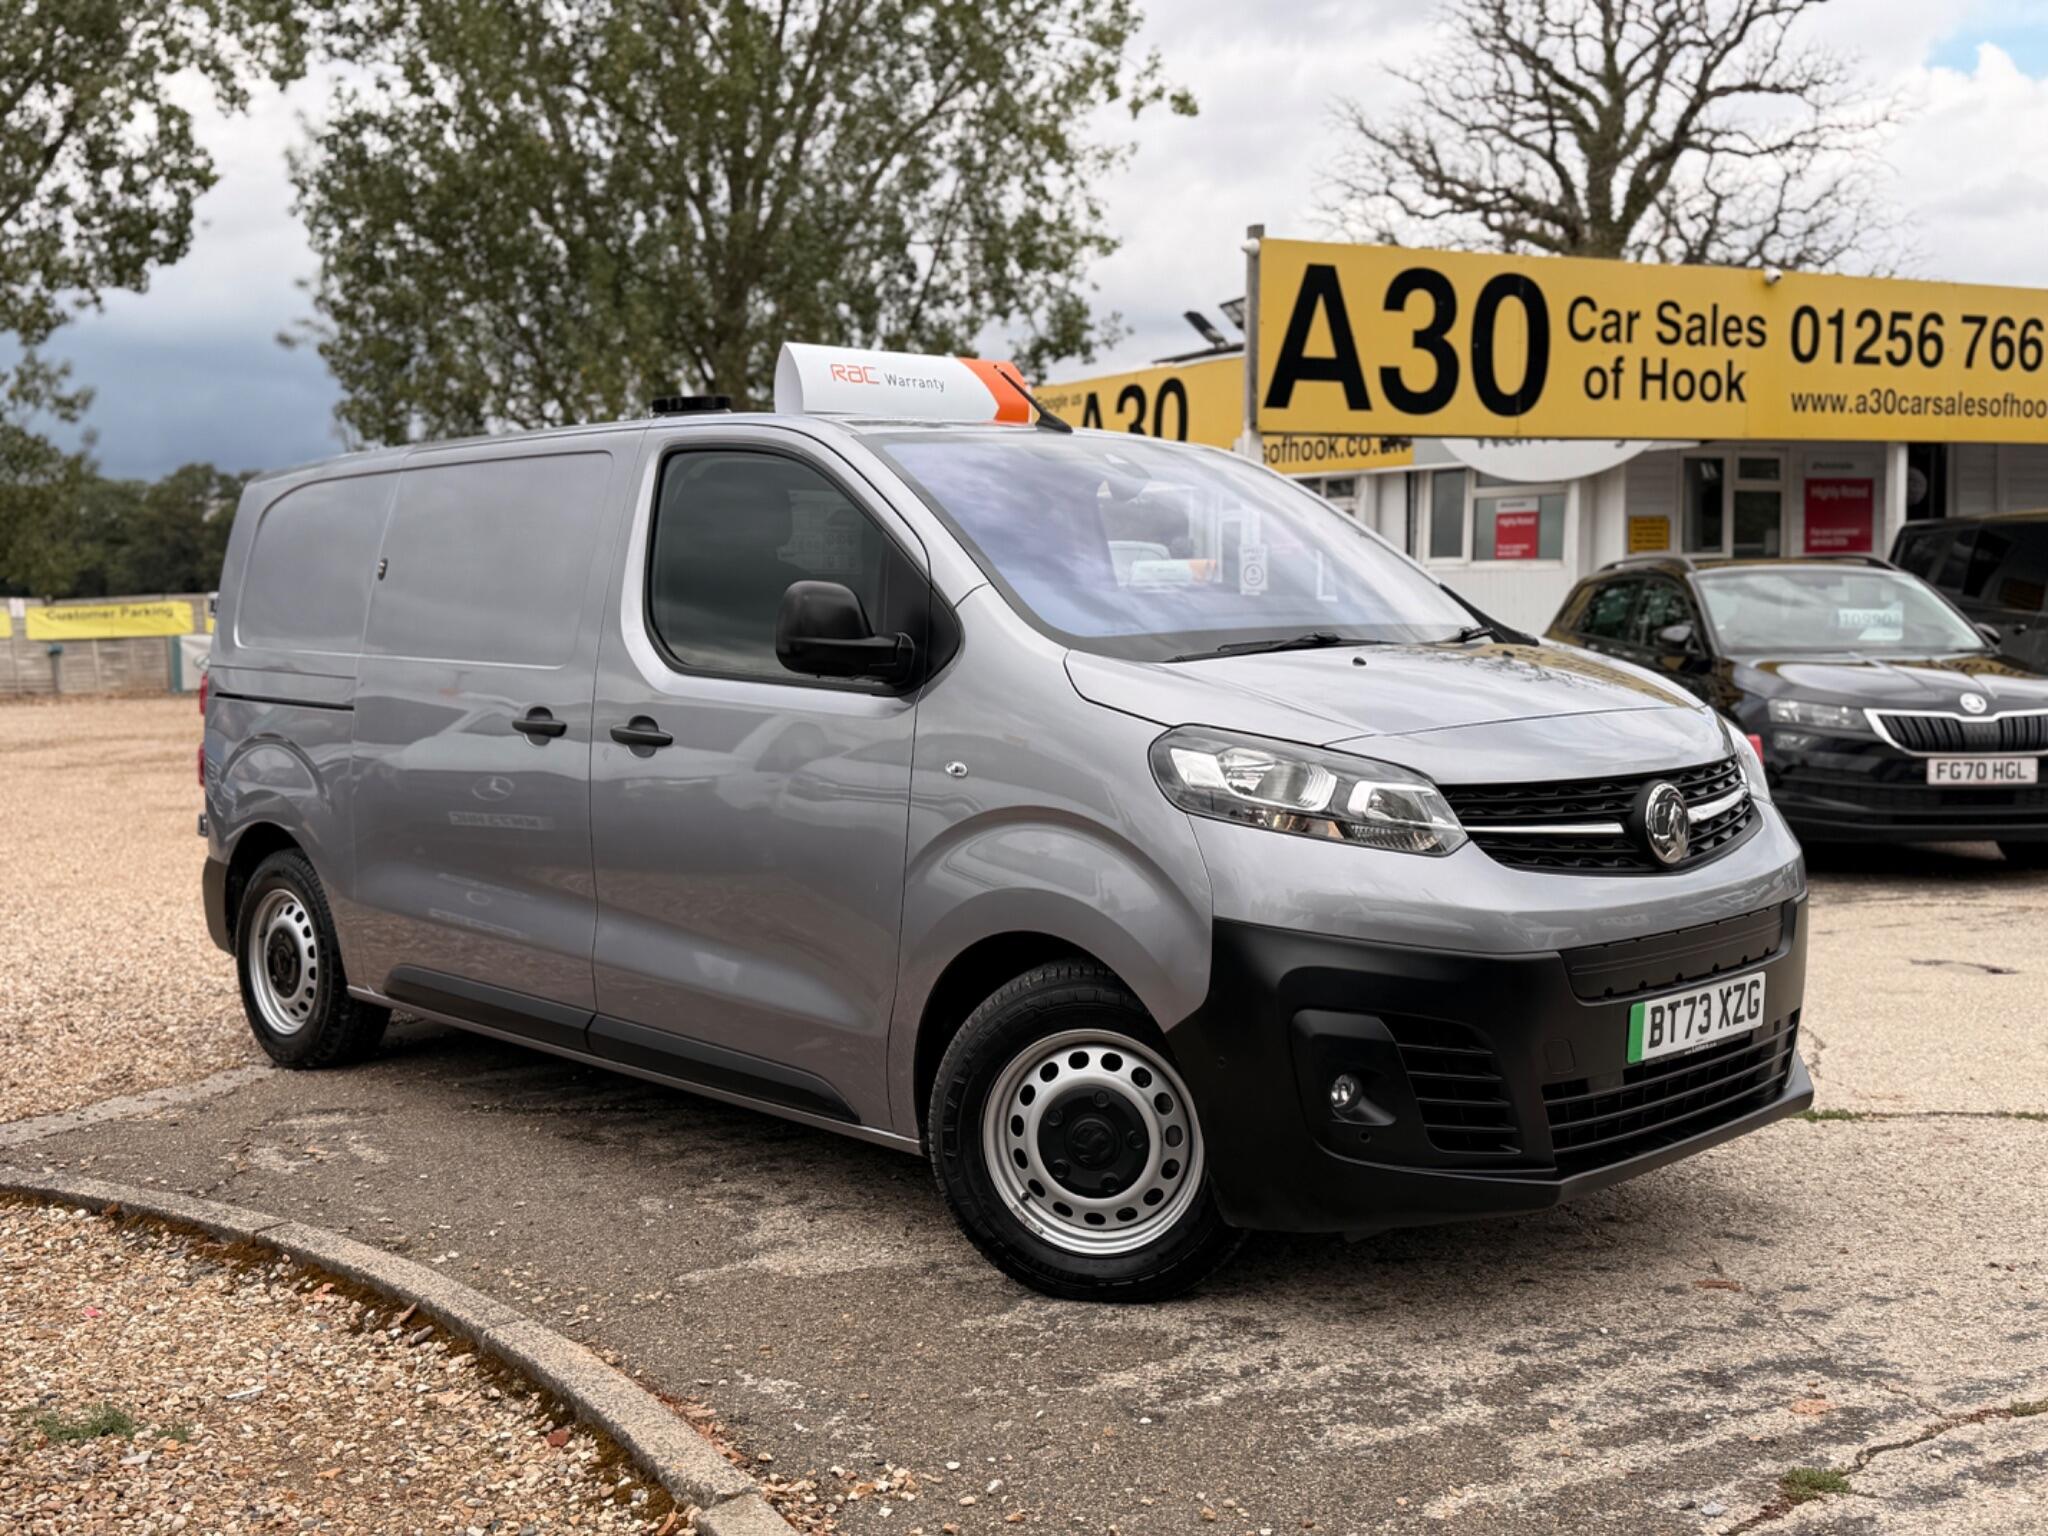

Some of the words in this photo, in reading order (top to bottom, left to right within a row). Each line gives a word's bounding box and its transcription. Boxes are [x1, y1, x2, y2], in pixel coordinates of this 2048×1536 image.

[1263, 263, 1551, 417] A30
[1567, 295, 1641, 345] Car
[1656, 300, 1768, 348] Sales
[1790, 304, 1945, 369] 01256
[1961, 314, 2045, 373] 766
[884, 373, 946, 392] Warranty
[1583, 355, 1624, 401] of
[1640, 357, 1748, 403] Hook
[1083, 377, 1189, 442] A30
[46, 606, 115, 621] Customer
[119, 604, 174, 619] Parking
[1936, 762, 1987, 780] FG70
[1994, 761, 2028, 780] HGL
[1648, 992, 1712, 1049] BT73
[1718, 979, 1761, 1030] XZG
